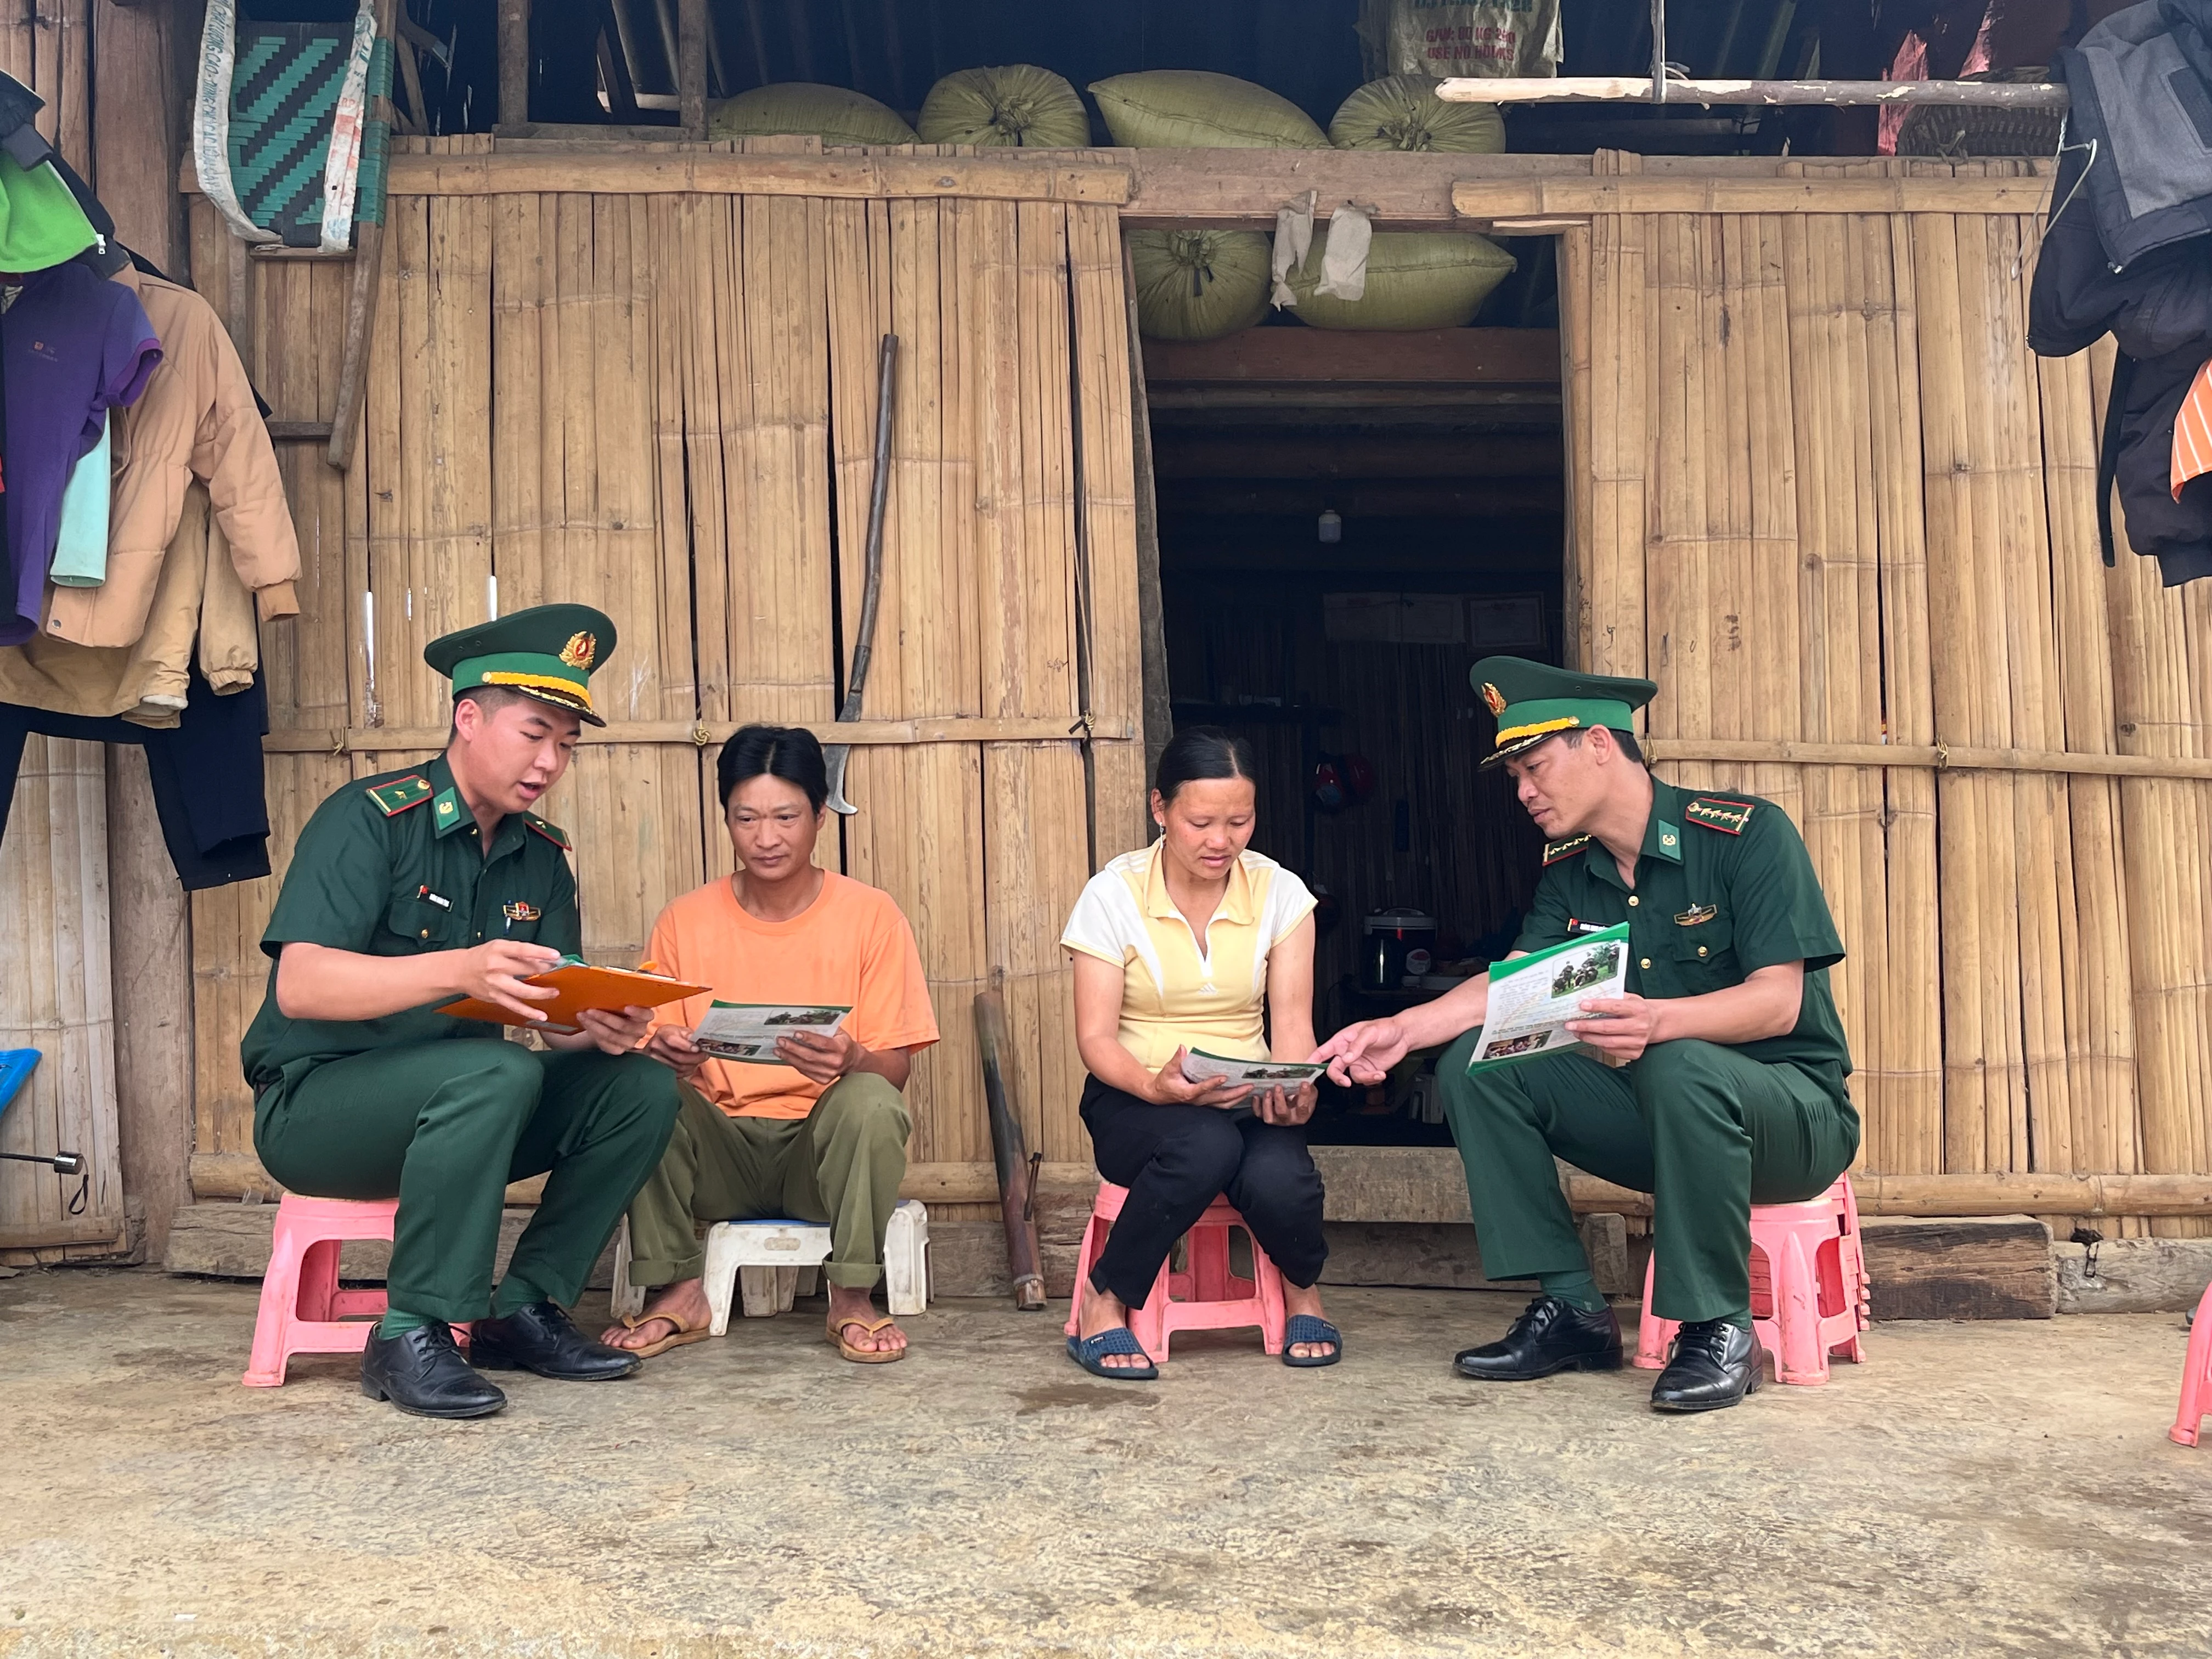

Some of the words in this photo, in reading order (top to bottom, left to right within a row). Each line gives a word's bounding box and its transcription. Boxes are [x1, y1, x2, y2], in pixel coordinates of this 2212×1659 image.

[1427, 47, 1449, 60] USE
[1454, 46, 1471, 59] NO
[204, 53, 222, 75] CAO
